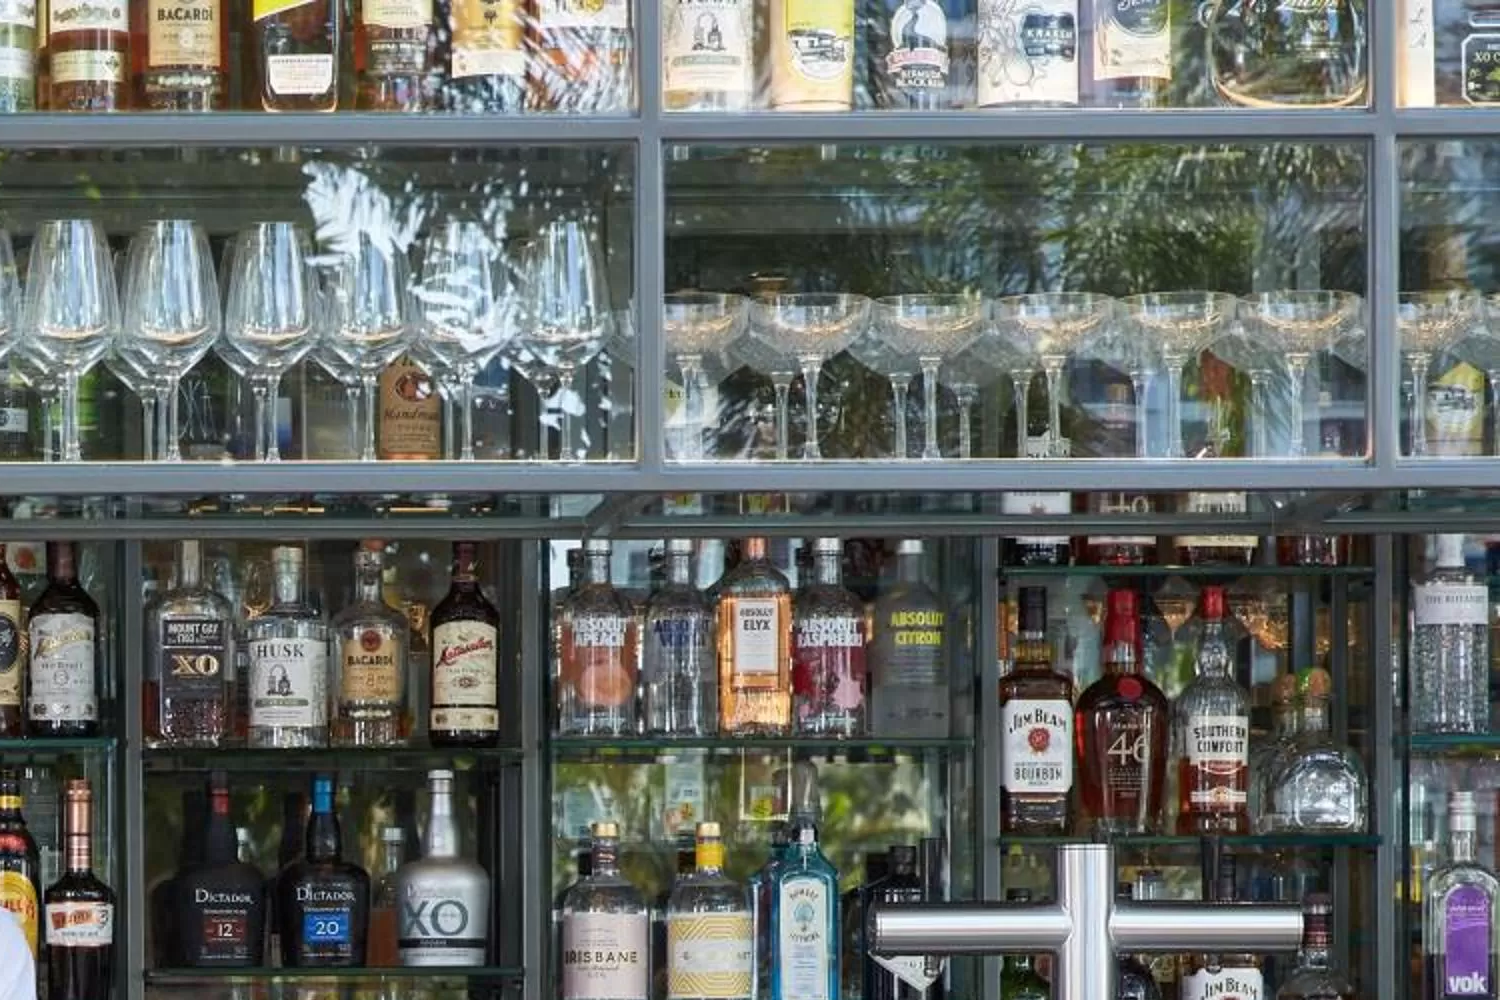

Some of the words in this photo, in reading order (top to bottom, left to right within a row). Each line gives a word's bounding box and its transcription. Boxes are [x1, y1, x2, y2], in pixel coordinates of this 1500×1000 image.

[743, 620, 772, 632] ELYX
[891, 612, 944, 626] ABSOLUT
[167, 623, 200, 634] MOUNT
[894, 632, 941, 646] CITRON
[257, 643, 305, 658] HUSK
[171, 654, 220, 677] XO
[1009, 712, 1034, 734] JIM
[1034, 707, 1067, 733] BEAM
[1194, 725, 1246, 739] SOUTHERN
[1107, 731, 1150, 767] 46
[1197, 740, 1244, 754] COMFORT
[1013, 767, 1063, 781] BOURBON
[195, 887, 254, 904] DICTADOR
[297, 883, 356, 901] DICTADOR
[403, 899, 469, 937] XO
[218, 923, 234, 938] 12
[316, 921, 340, 936] 20
[1449, 971, 1488, 994] vok
